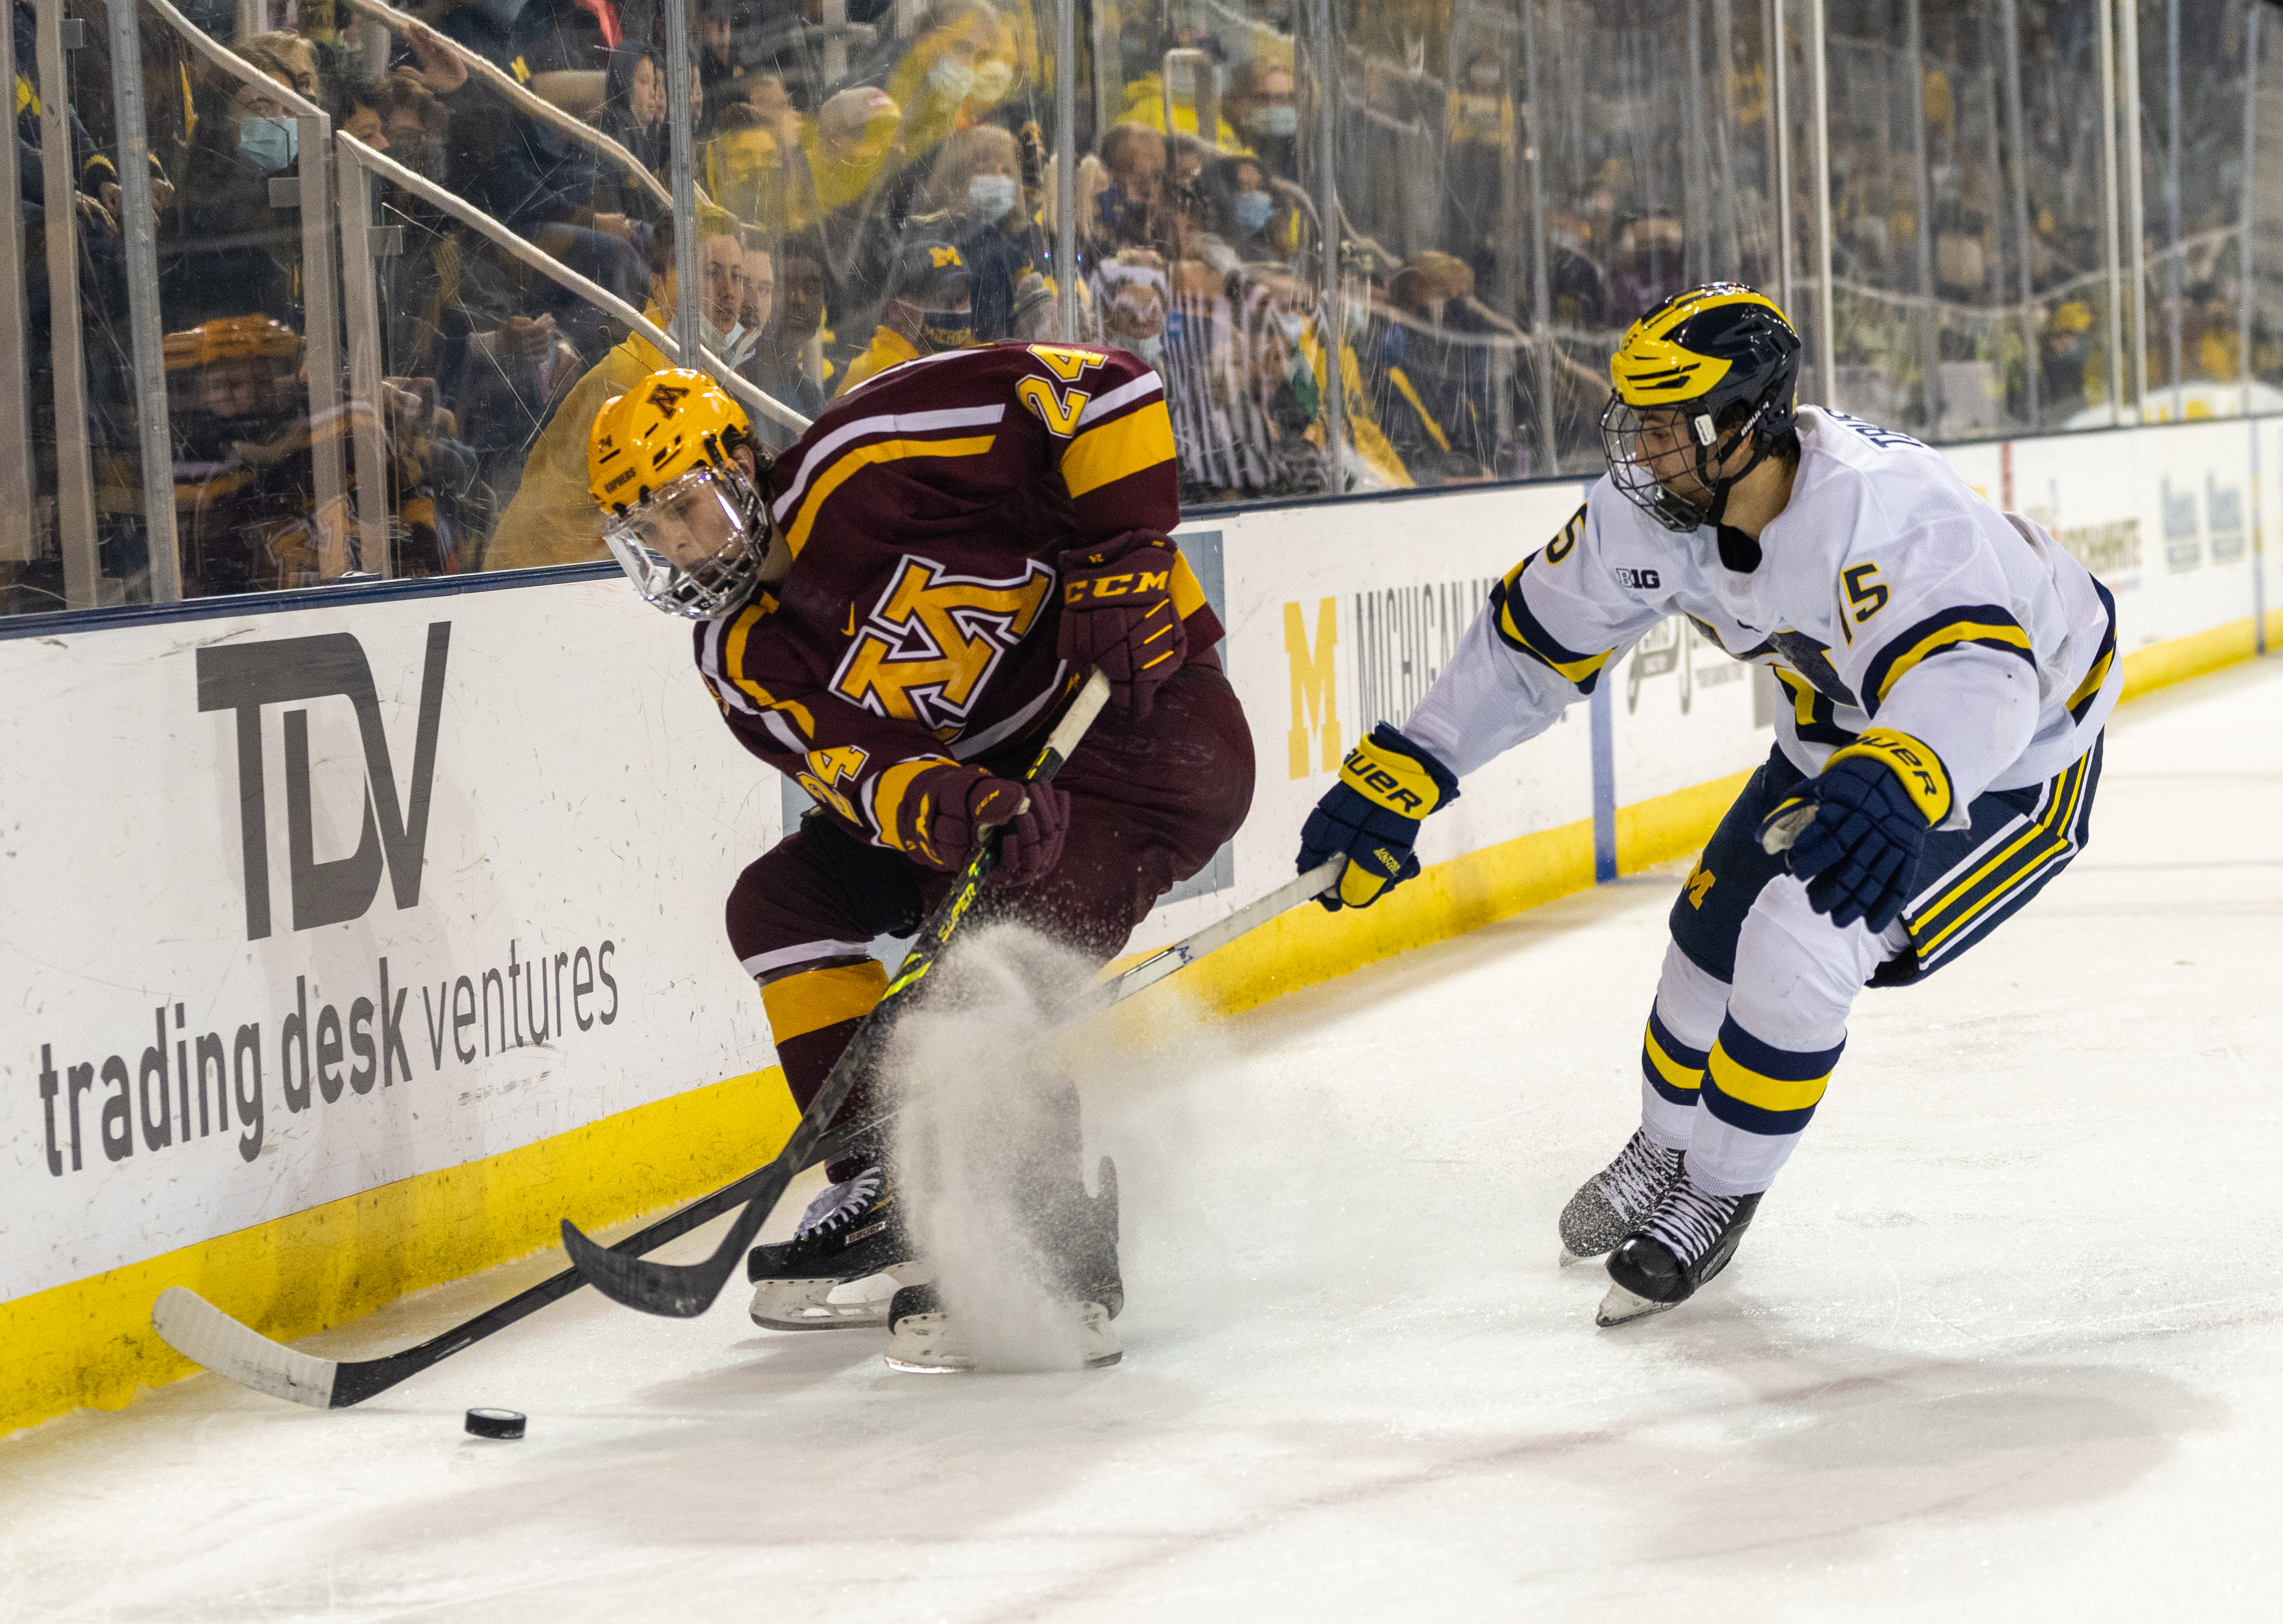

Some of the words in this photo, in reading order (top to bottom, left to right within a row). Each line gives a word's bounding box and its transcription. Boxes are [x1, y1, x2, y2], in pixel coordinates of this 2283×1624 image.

[929, 246, 963, 268] M
[1015, 344, 1109, 439] 24
[1064, 570, 1169, 604] CCM
[1283, 596, 1342, 780] M
[196, 621, 452, 941] TDV
[1684, 857, 1717, 911] M
[40, 1003, 264, 1178] trading
[282, 956, 413, 1114] desk
[422, 939, 620, 1071] ventures
